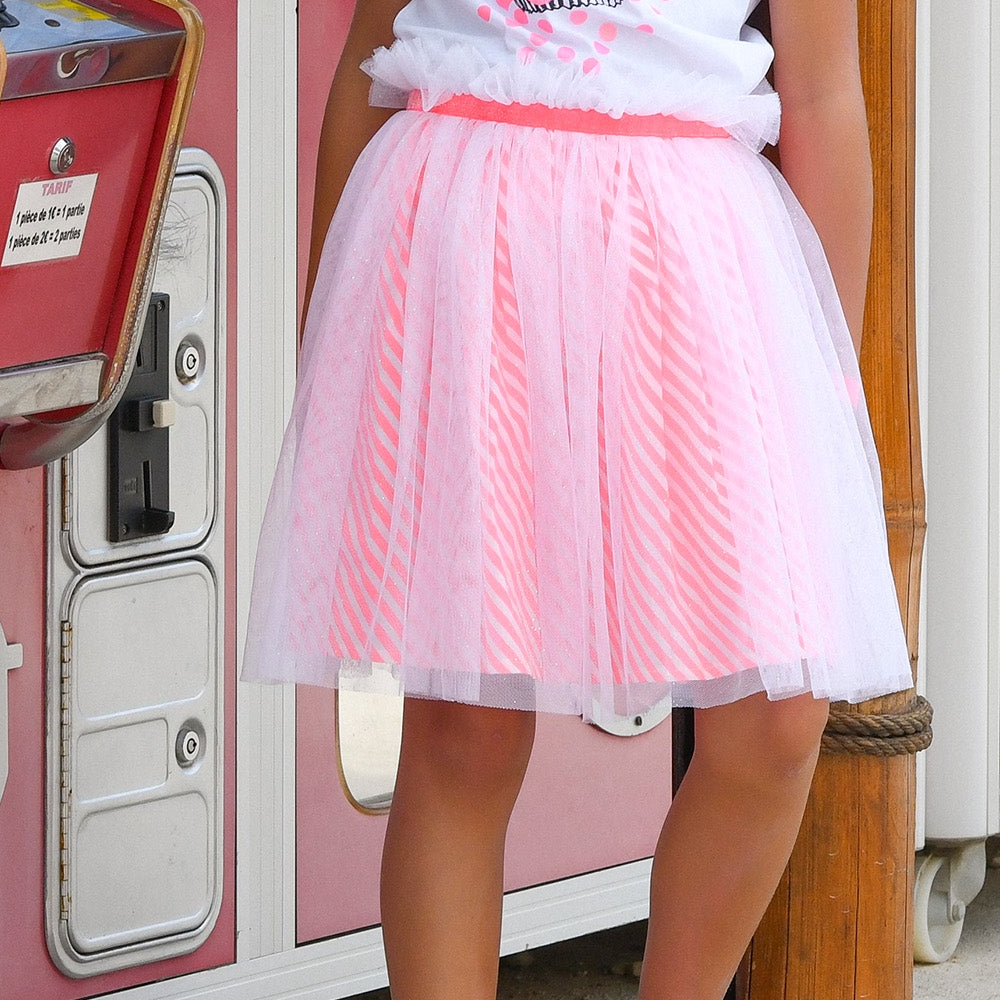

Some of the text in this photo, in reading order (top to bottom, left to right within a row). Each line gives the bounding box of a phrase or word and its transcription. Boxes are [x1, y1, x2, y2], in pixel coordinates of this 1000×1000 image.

[41, 180, 73, 196] TARIF
[19, 210, 38, 227] pièce
[38, 208, 47, 222] de
[65, 202, 86, 220] partie
[11, 234, 30, 251] pièce
[31, 232, 40, 246] de
[58, 227, 82, 245] parties
